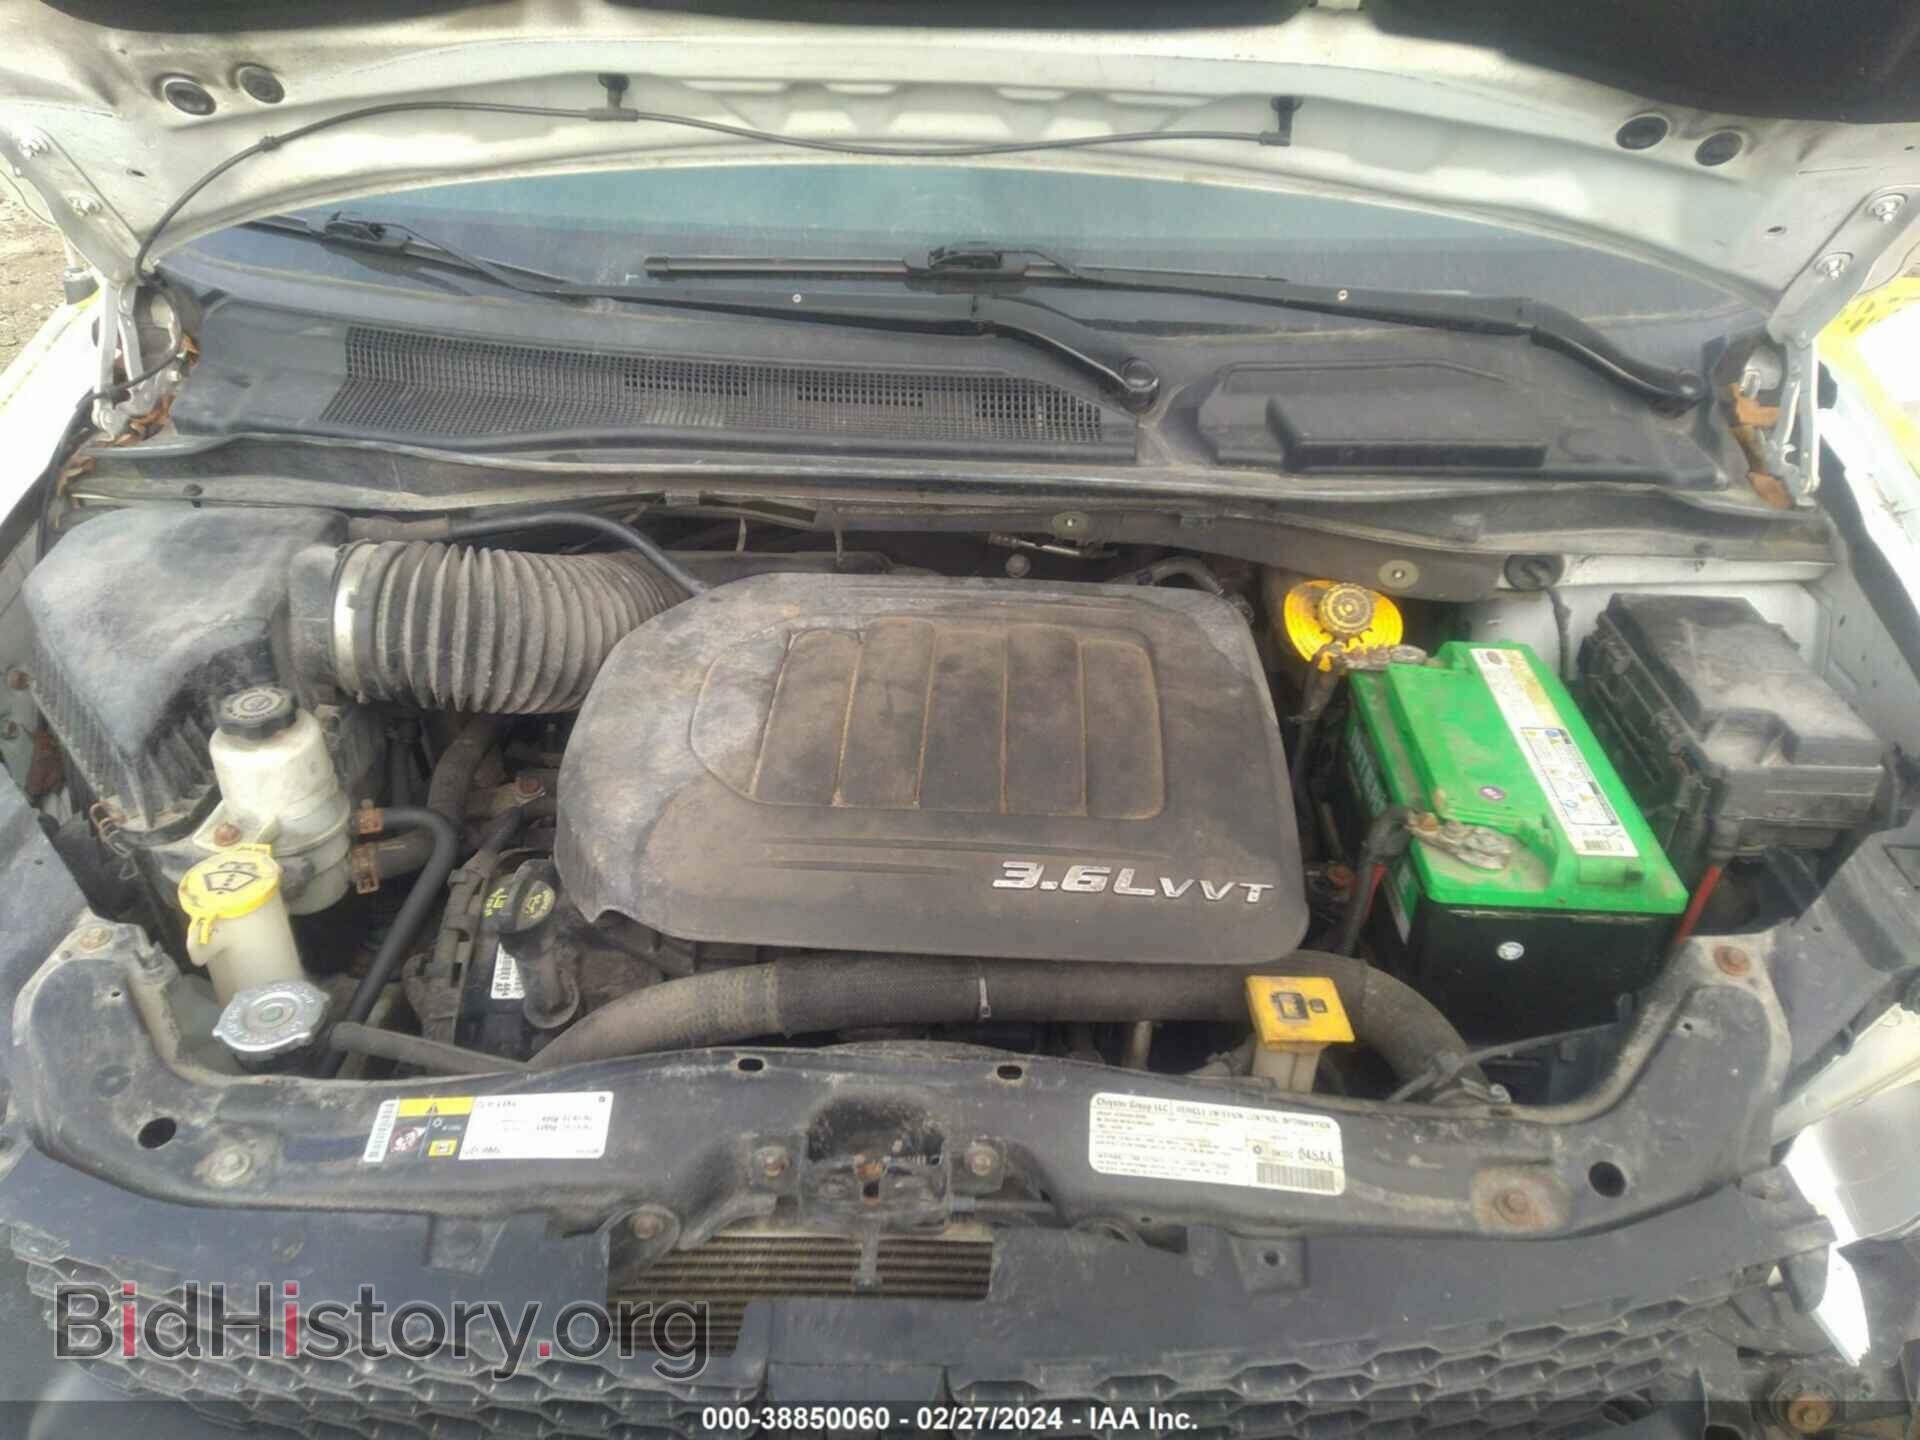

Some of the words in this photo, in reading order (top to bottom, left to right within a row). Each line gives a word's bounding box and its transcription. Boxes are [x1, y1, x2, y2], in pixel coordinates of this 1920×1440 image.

[992, 861, 1156, 896] 3.6L
[1159, 877, 1275, 903] VVT
[1154, 1104, 1169, 1113] LLC
